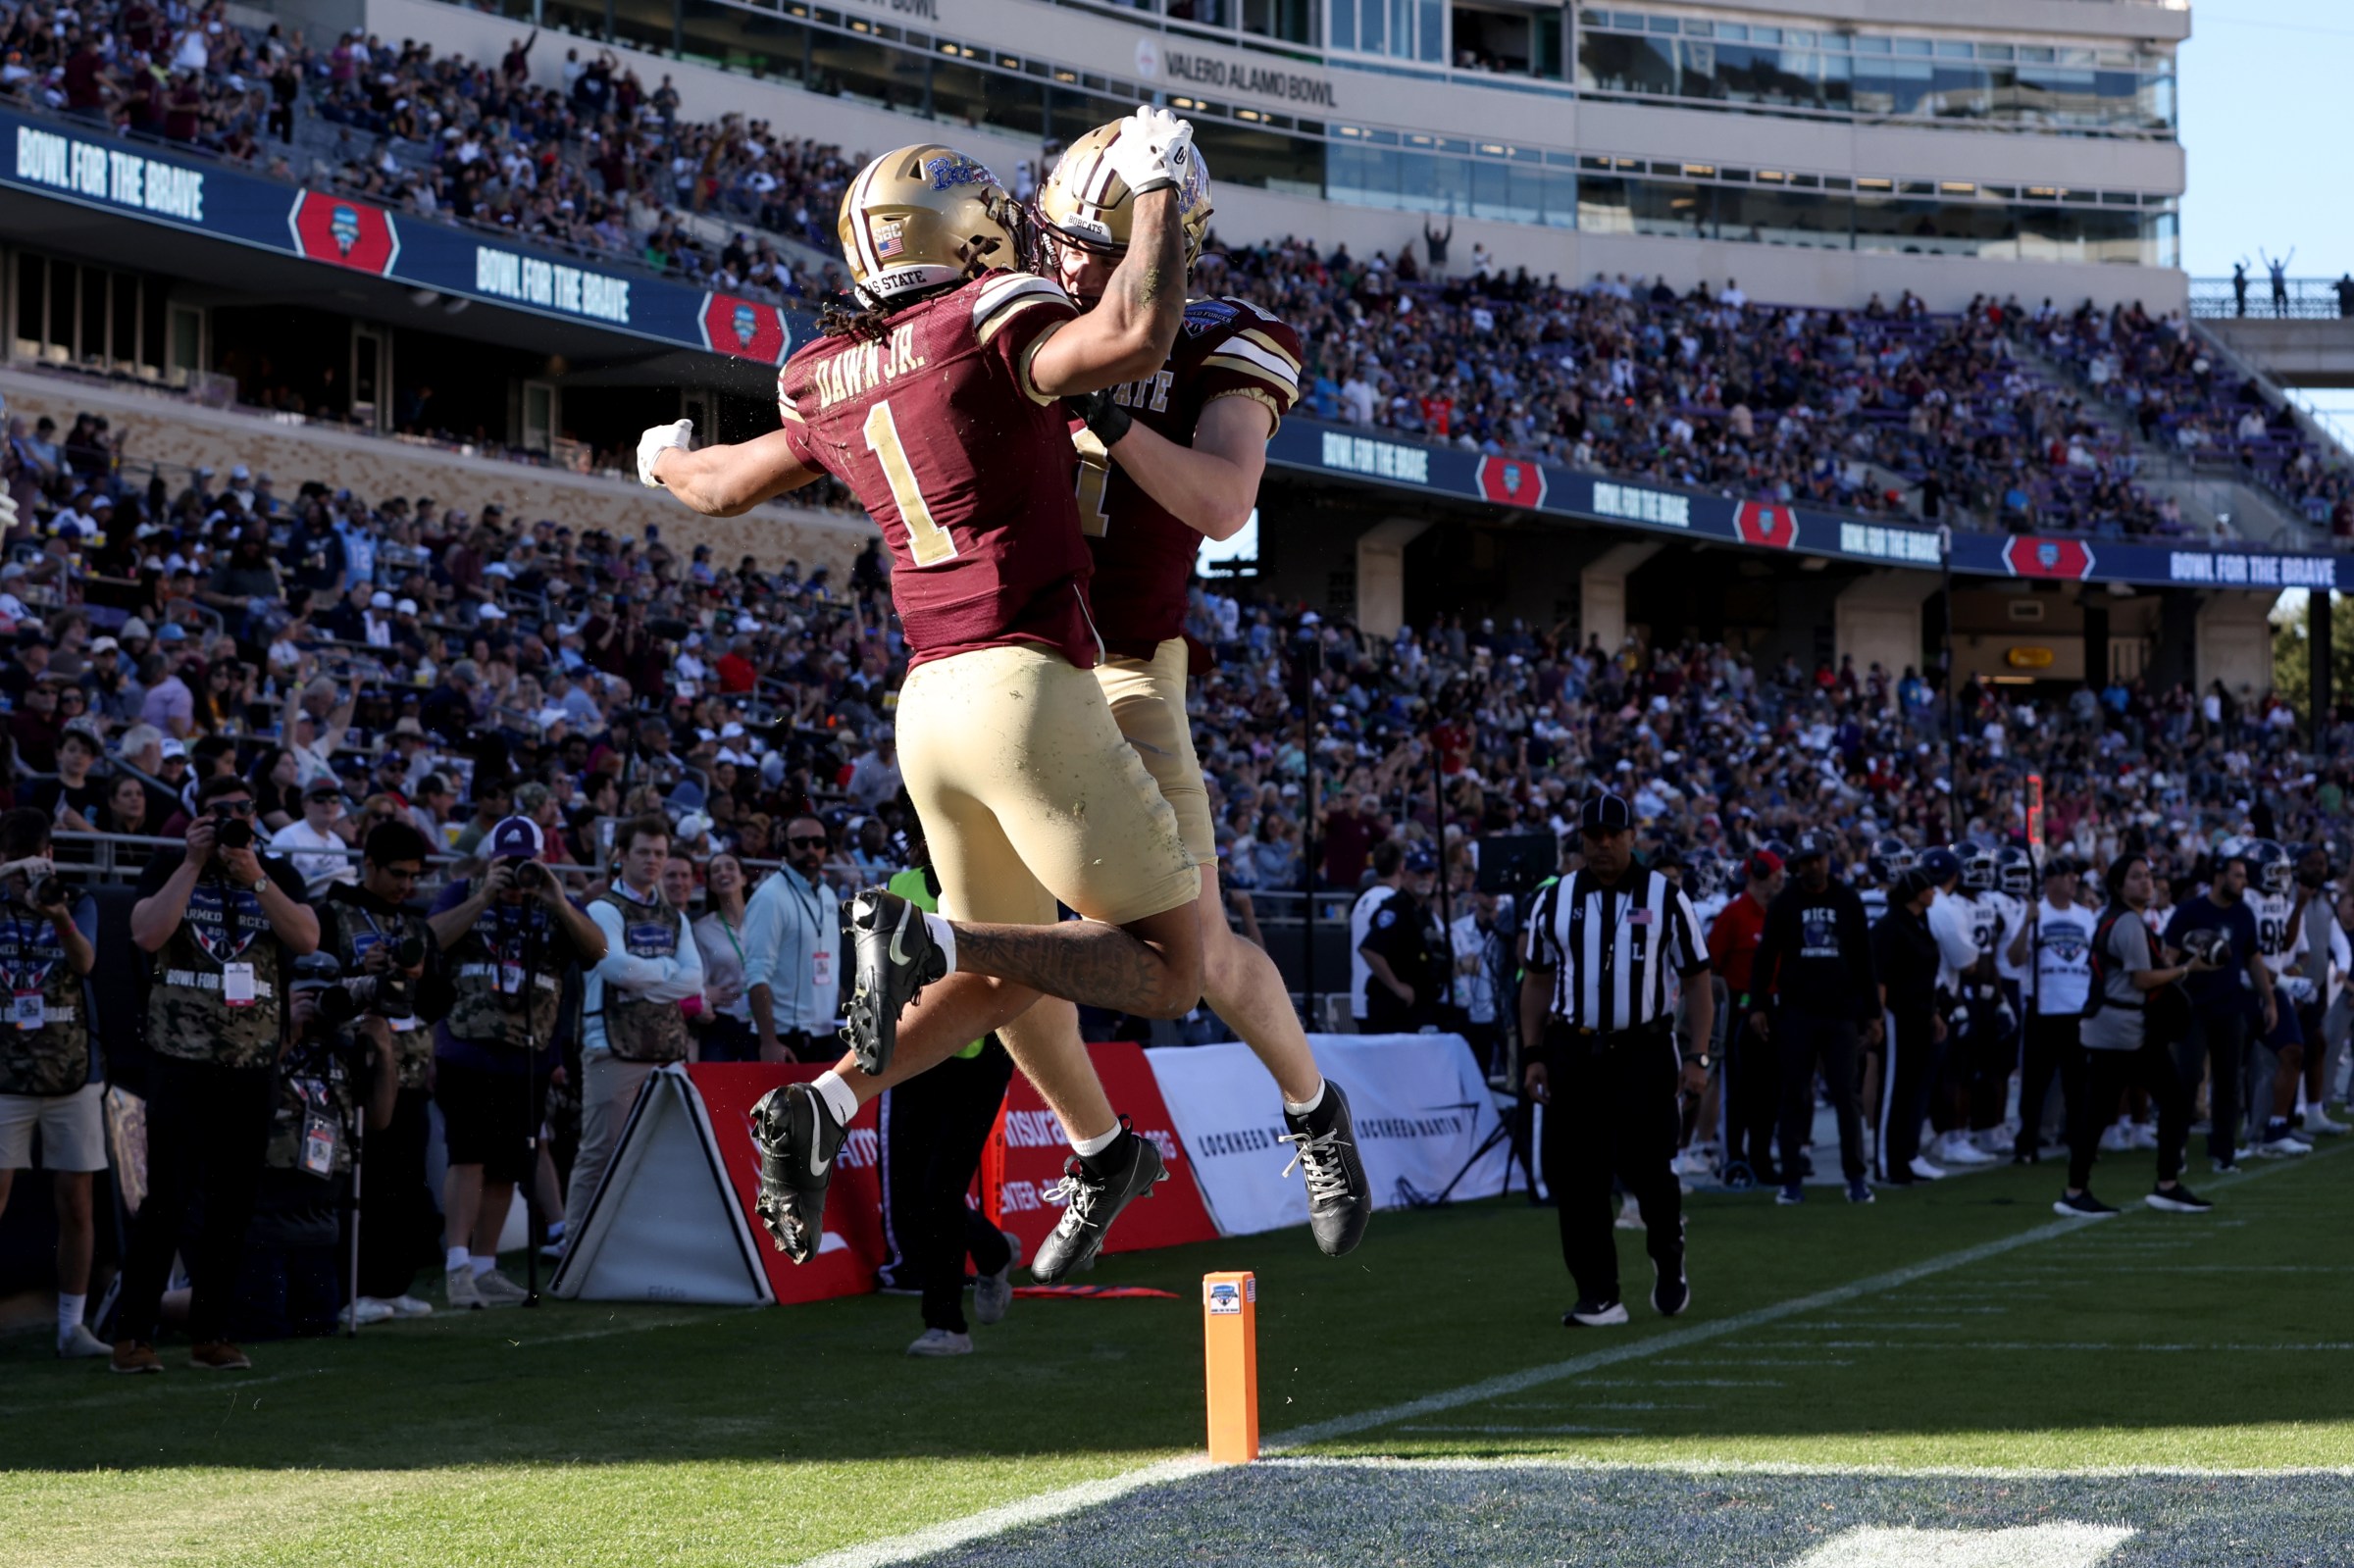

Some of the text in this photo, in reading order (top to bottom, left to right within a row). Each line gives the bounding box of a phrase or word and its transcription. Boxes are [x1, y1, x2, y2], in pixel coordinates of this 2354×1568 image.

[1164, 51, 1338, 108] VALERO ALAMO BOWL
[17, 126, 204, 221] BOWL FOR THE BRAVE
[873, 223, 903, 243] SBC
[1068, 215, 1102, 234] BOBCATS
[477, 246, 631, 324] BOWL FOR THE BRAVE
[881, 271, 927, 290] STATE
[815, 322, 926, 409] DAWN JR.
[862, 399, 959, 568] 1
[2171, 551, 2335, 585] BOWL FOR THE BRAVE
[1801, 907, 1838, 924] RICE
[1631, 941, 1646, 961] L
[166, 968, 196, 987] BOWL
[196, 971, 220, 989] FOR
[1198, 1128, 1270, 1157] LOCKHEED
